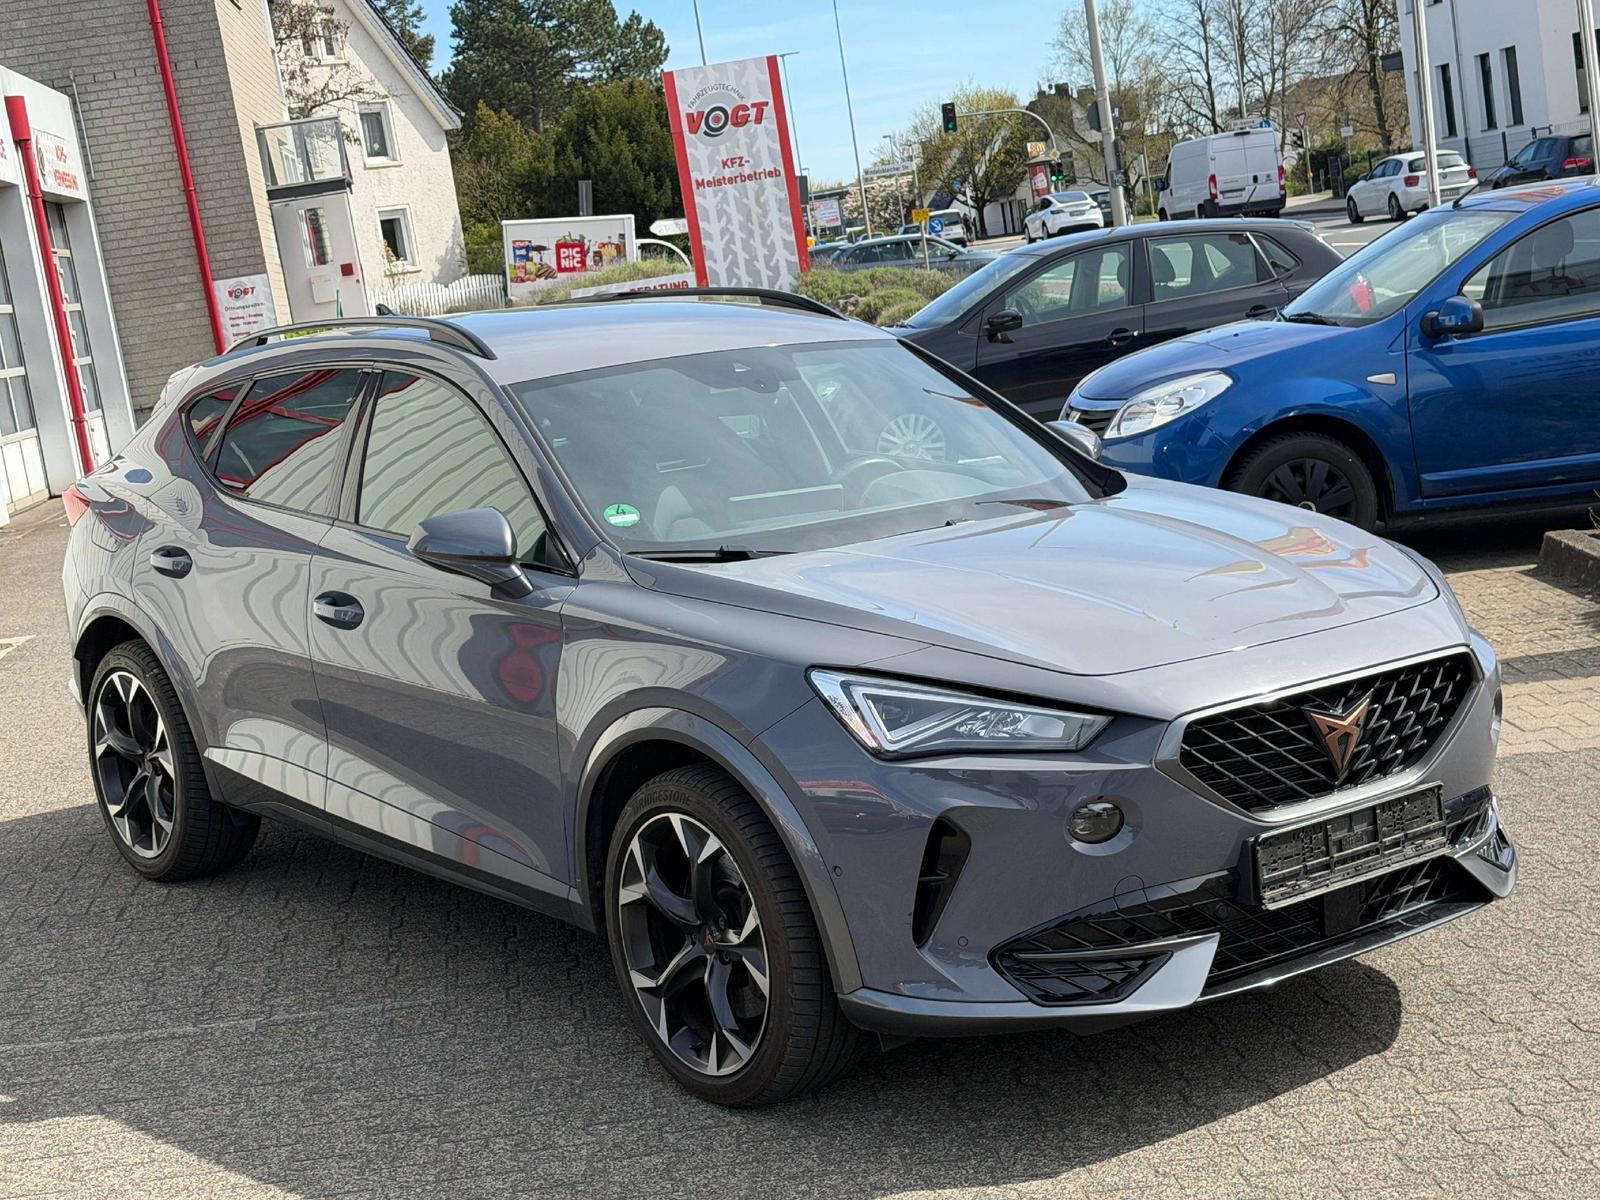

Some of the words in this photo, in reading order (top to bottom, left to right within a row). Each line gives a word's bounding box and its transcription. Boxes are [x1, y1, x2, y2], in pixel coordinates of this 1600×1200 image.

[687, 83, 746, 109] FAHRZEUGTECHNIK
[685, 101, 769, 138] VOGT
[721, 156, 750, 170] KFZ-
[695, 167, 781, 189] Meisterbetrieb
[560, 247, 582, 258] PIC
[227, 286, 256, 298] VOGT
[616, 505, 626, 515] 4
